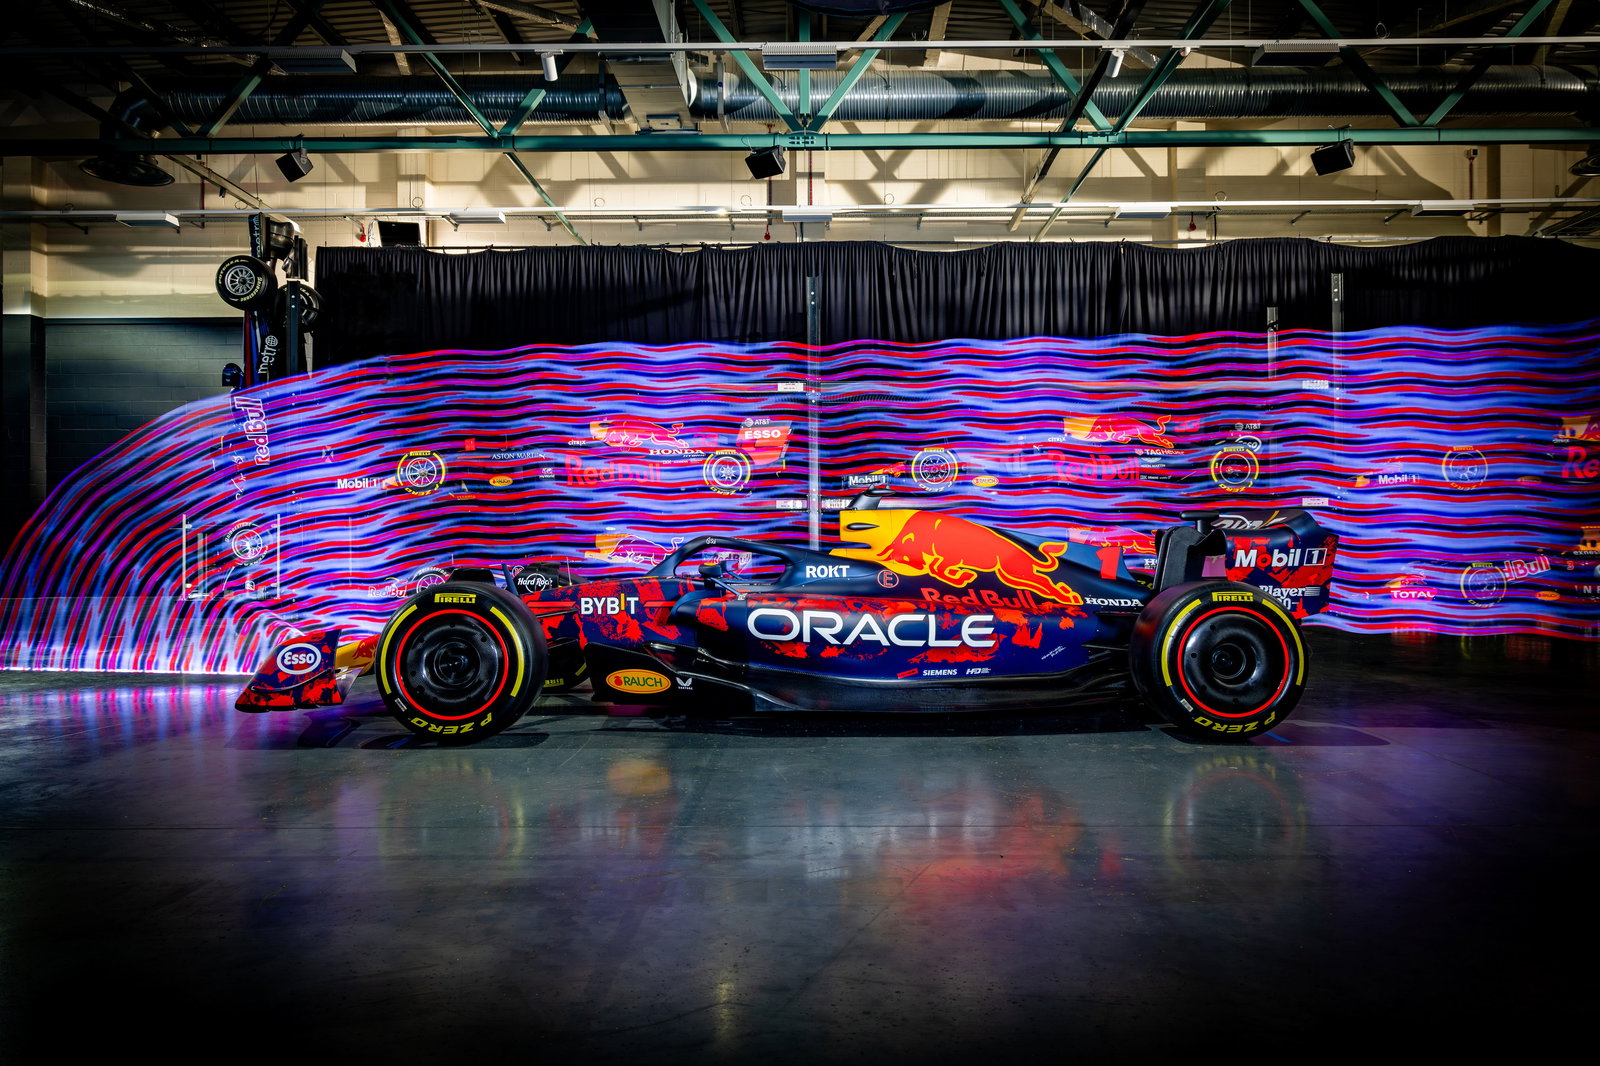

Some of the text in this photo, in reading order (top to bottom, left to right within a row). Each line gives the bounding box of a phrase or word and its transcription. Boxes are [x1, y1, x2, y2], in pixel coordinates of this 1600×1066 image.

[744, 429, 781, 440] ESSO
[336, 478, 369, 489] Mobil
[1378, 474, 1408, 485] Mobil
[1095, 546, 1122, 580] 1
[1234, 549, 1301, 568] Mobil
[805, 565, 850, 578] ROKT
[434, 593, 477, 604] PIRELLI
[1211, 591, 1254, 602] PIRELLI
[1390, 591, 1435, 599] TOTAL
[580, 594, 639, 615] BYBIT
[1085, 596, 1144, 607] HONDA
[747, 607, 997, 648] ORACLE
[922, 669, 958, 677] SIEMENS
[623, 676, 663, 688] RAUCH
[410, 712, 492, 735] P ZERO
[1194, 711, 1276, 733] P ZERO
